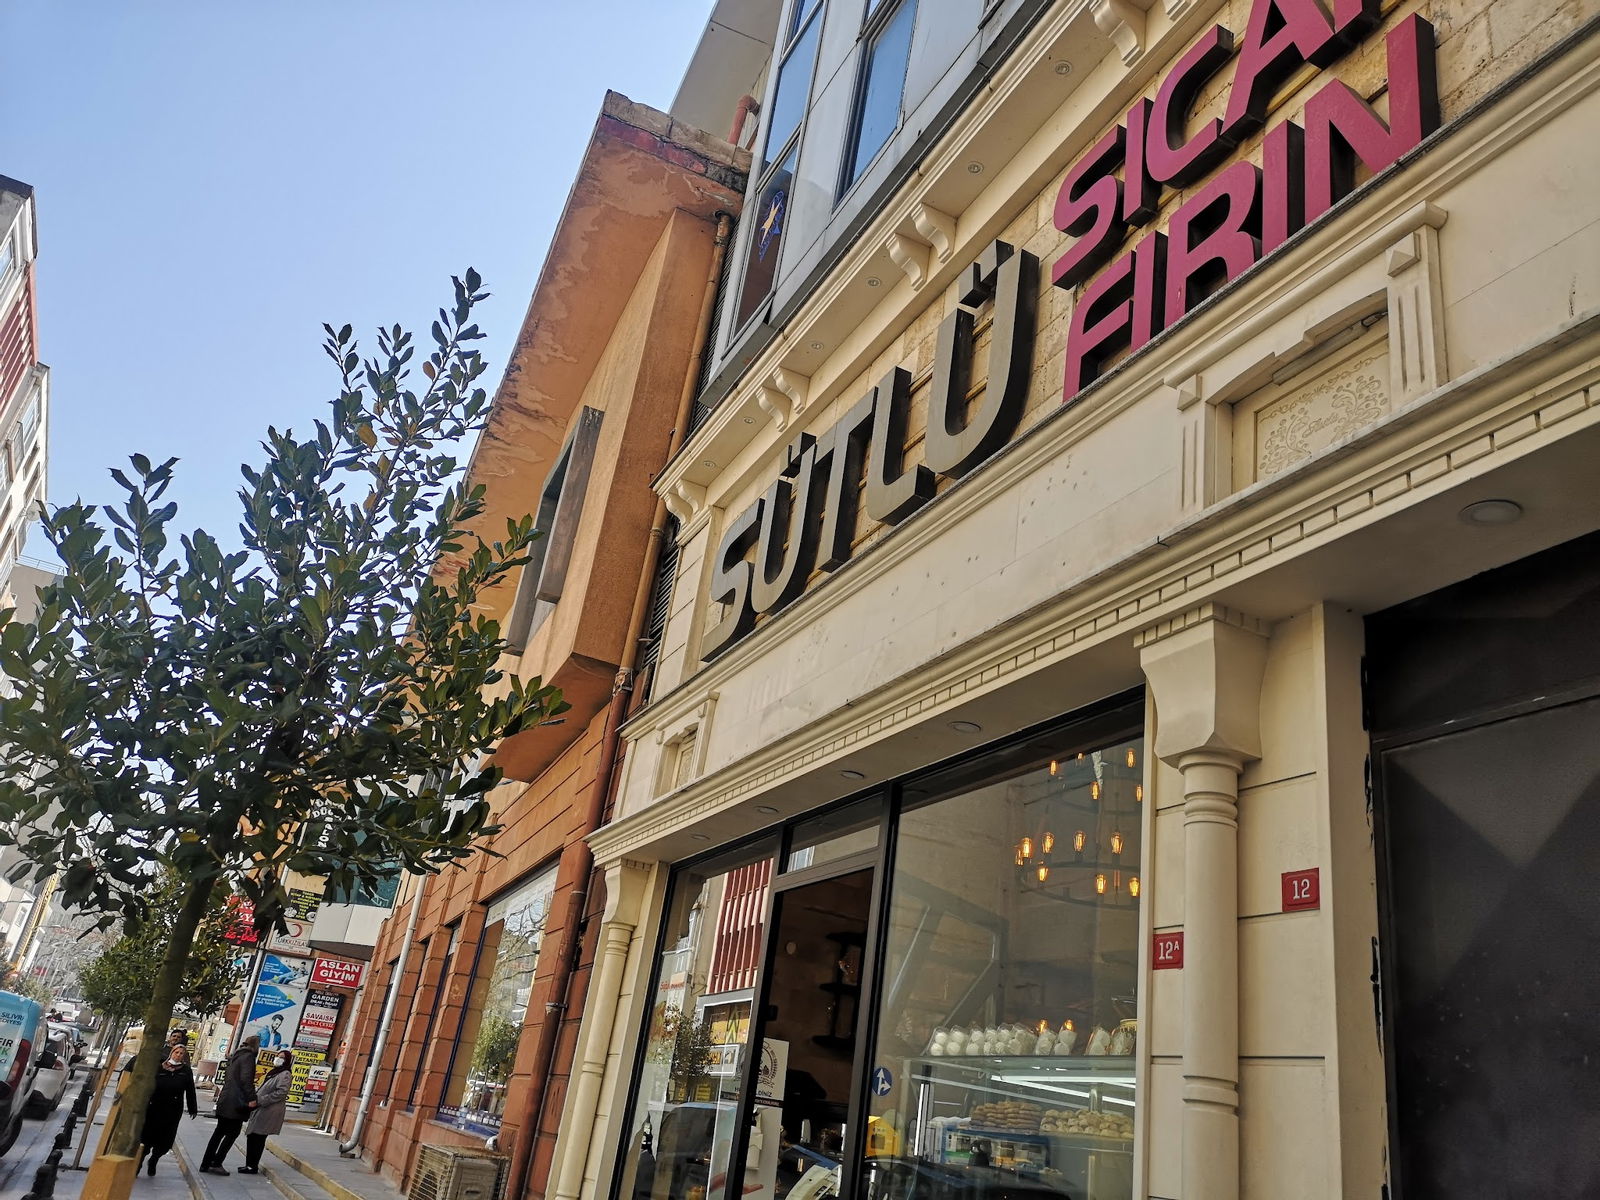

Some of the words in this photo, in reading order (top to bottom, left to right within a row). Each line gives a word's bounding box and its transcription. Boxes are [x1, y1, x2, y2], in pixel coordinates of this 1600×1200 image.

[1063, 12, 1437, 403] FIRIN
[700, 239, 1039, 662] SÜTLÜ
[1292, 878, 1311, 900] 12
[1158, 940, 1180, 961] 12A
[319, 960, 360, 973] ASLAN
[319, 969, 356, 981] GİYİM
[311, 993, 340, 1003] GARDEN
